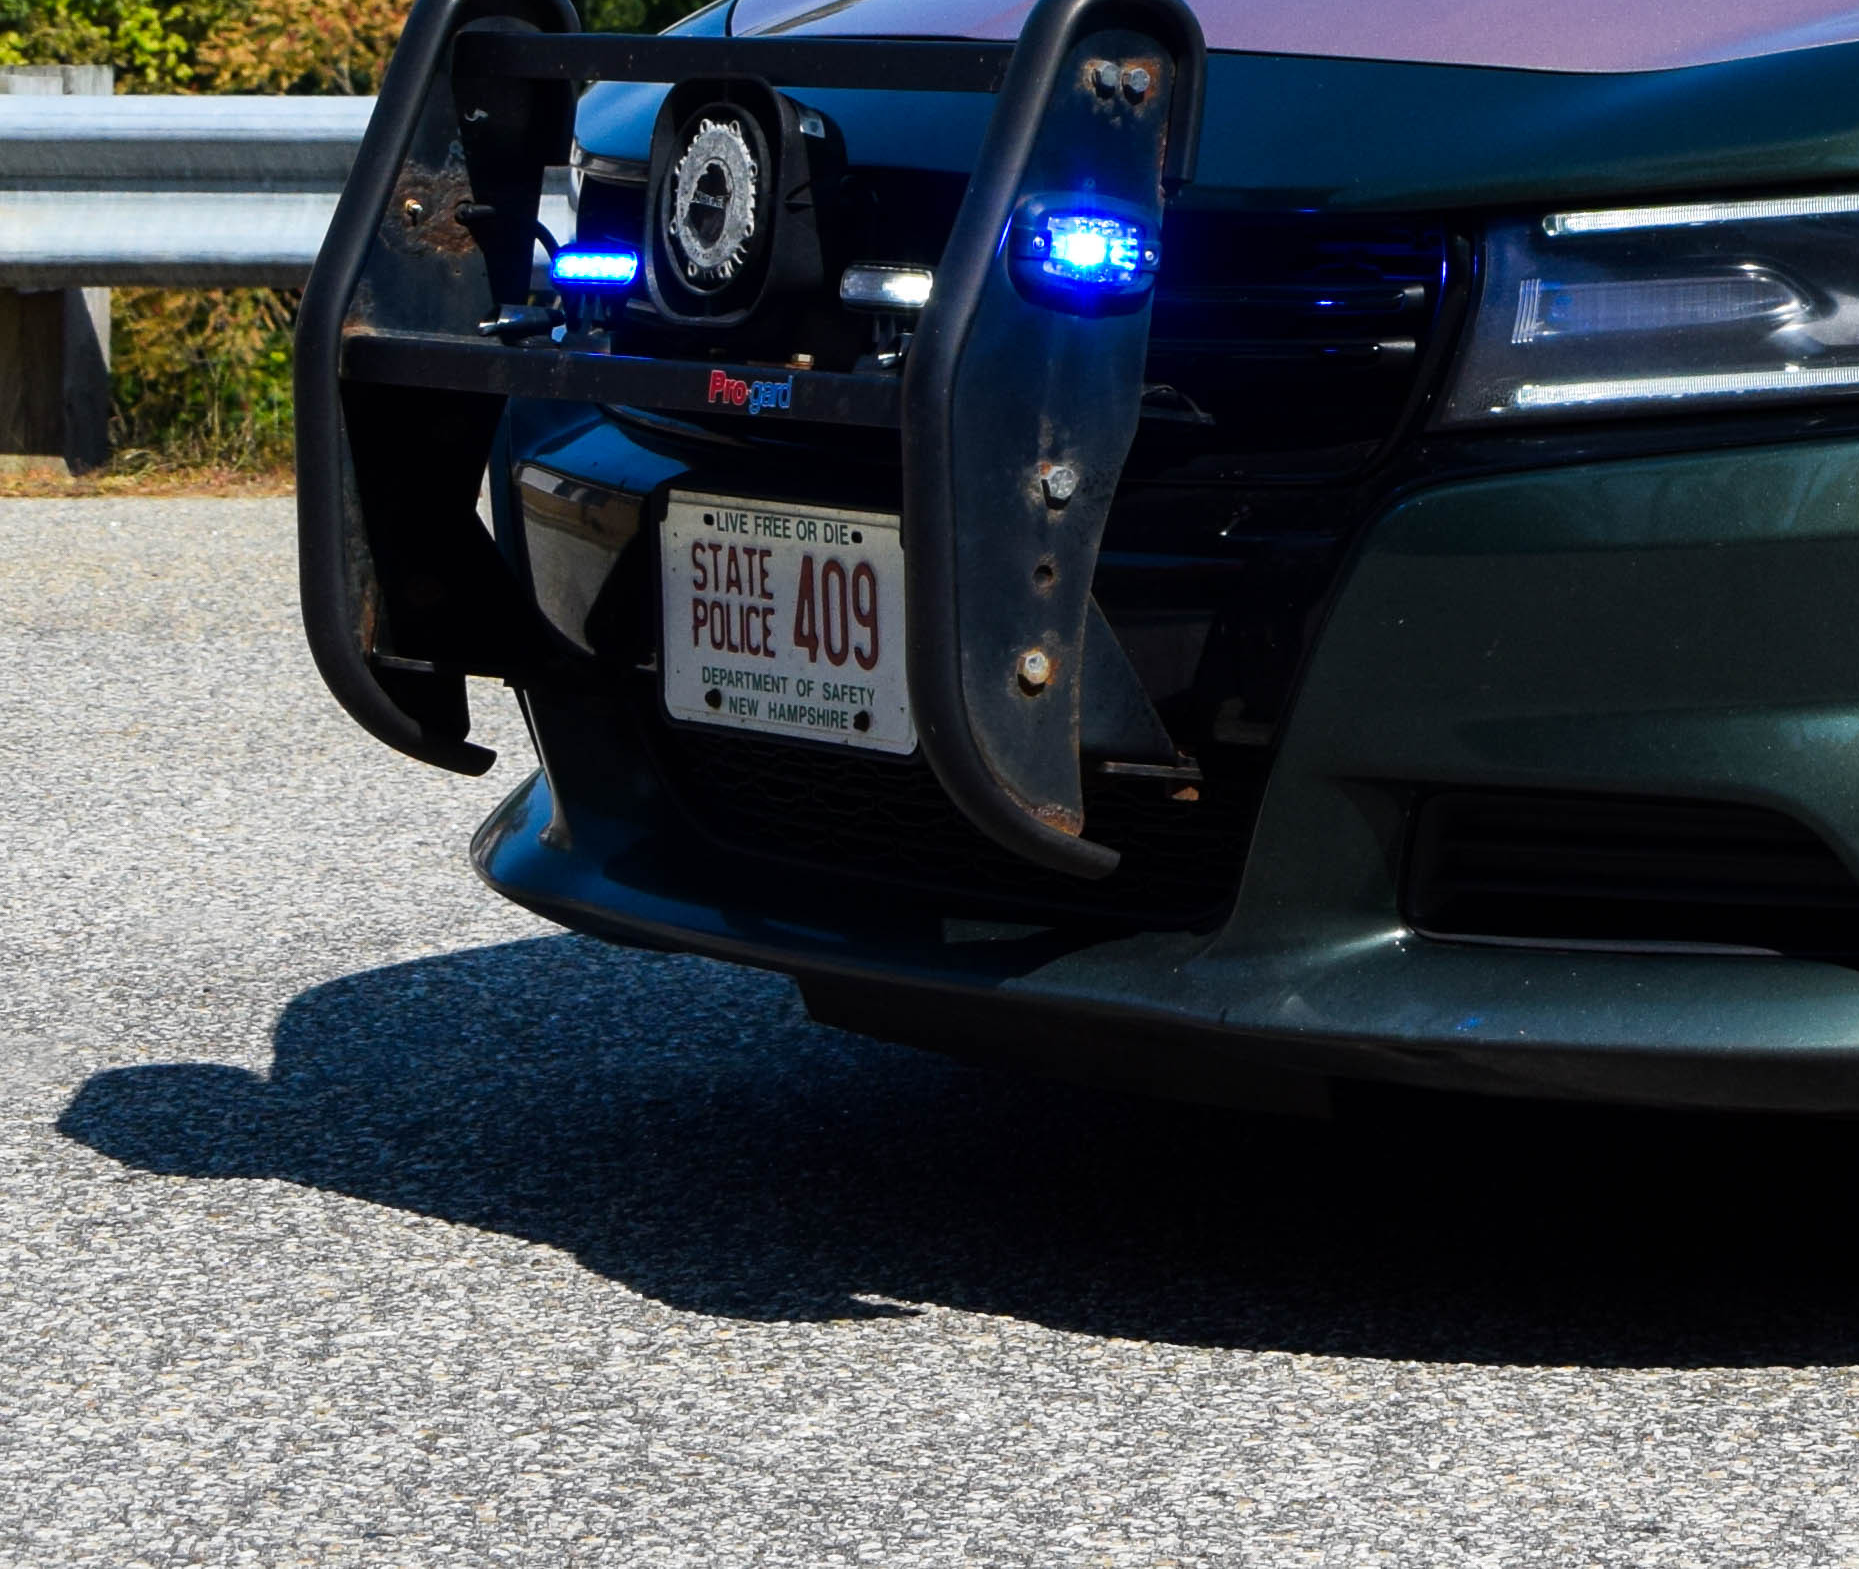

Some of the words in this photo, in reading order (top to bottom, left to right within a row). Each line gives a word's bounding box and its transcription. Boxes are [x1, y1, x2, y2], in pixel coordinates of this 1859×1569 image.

[717, 511, 749, 532] LIVE
[755, 515, 791, 539] FREE
[796, 519, 817, 542] OR
[824, 522, 850, 545] DIE
[691, 541, 774, 600] STATE
[691, 597, 776, 659] POLICE
[793, 554, 879, 671] 409
[702, 666, 788, 695] DEPARTMENT
[796, 678, 814, 698] OF
[822, 682, 875, 707] SAFETY
[729, 696, 759, 717] NEW
[768, 702, 849, 729] HAMPSHIRE
